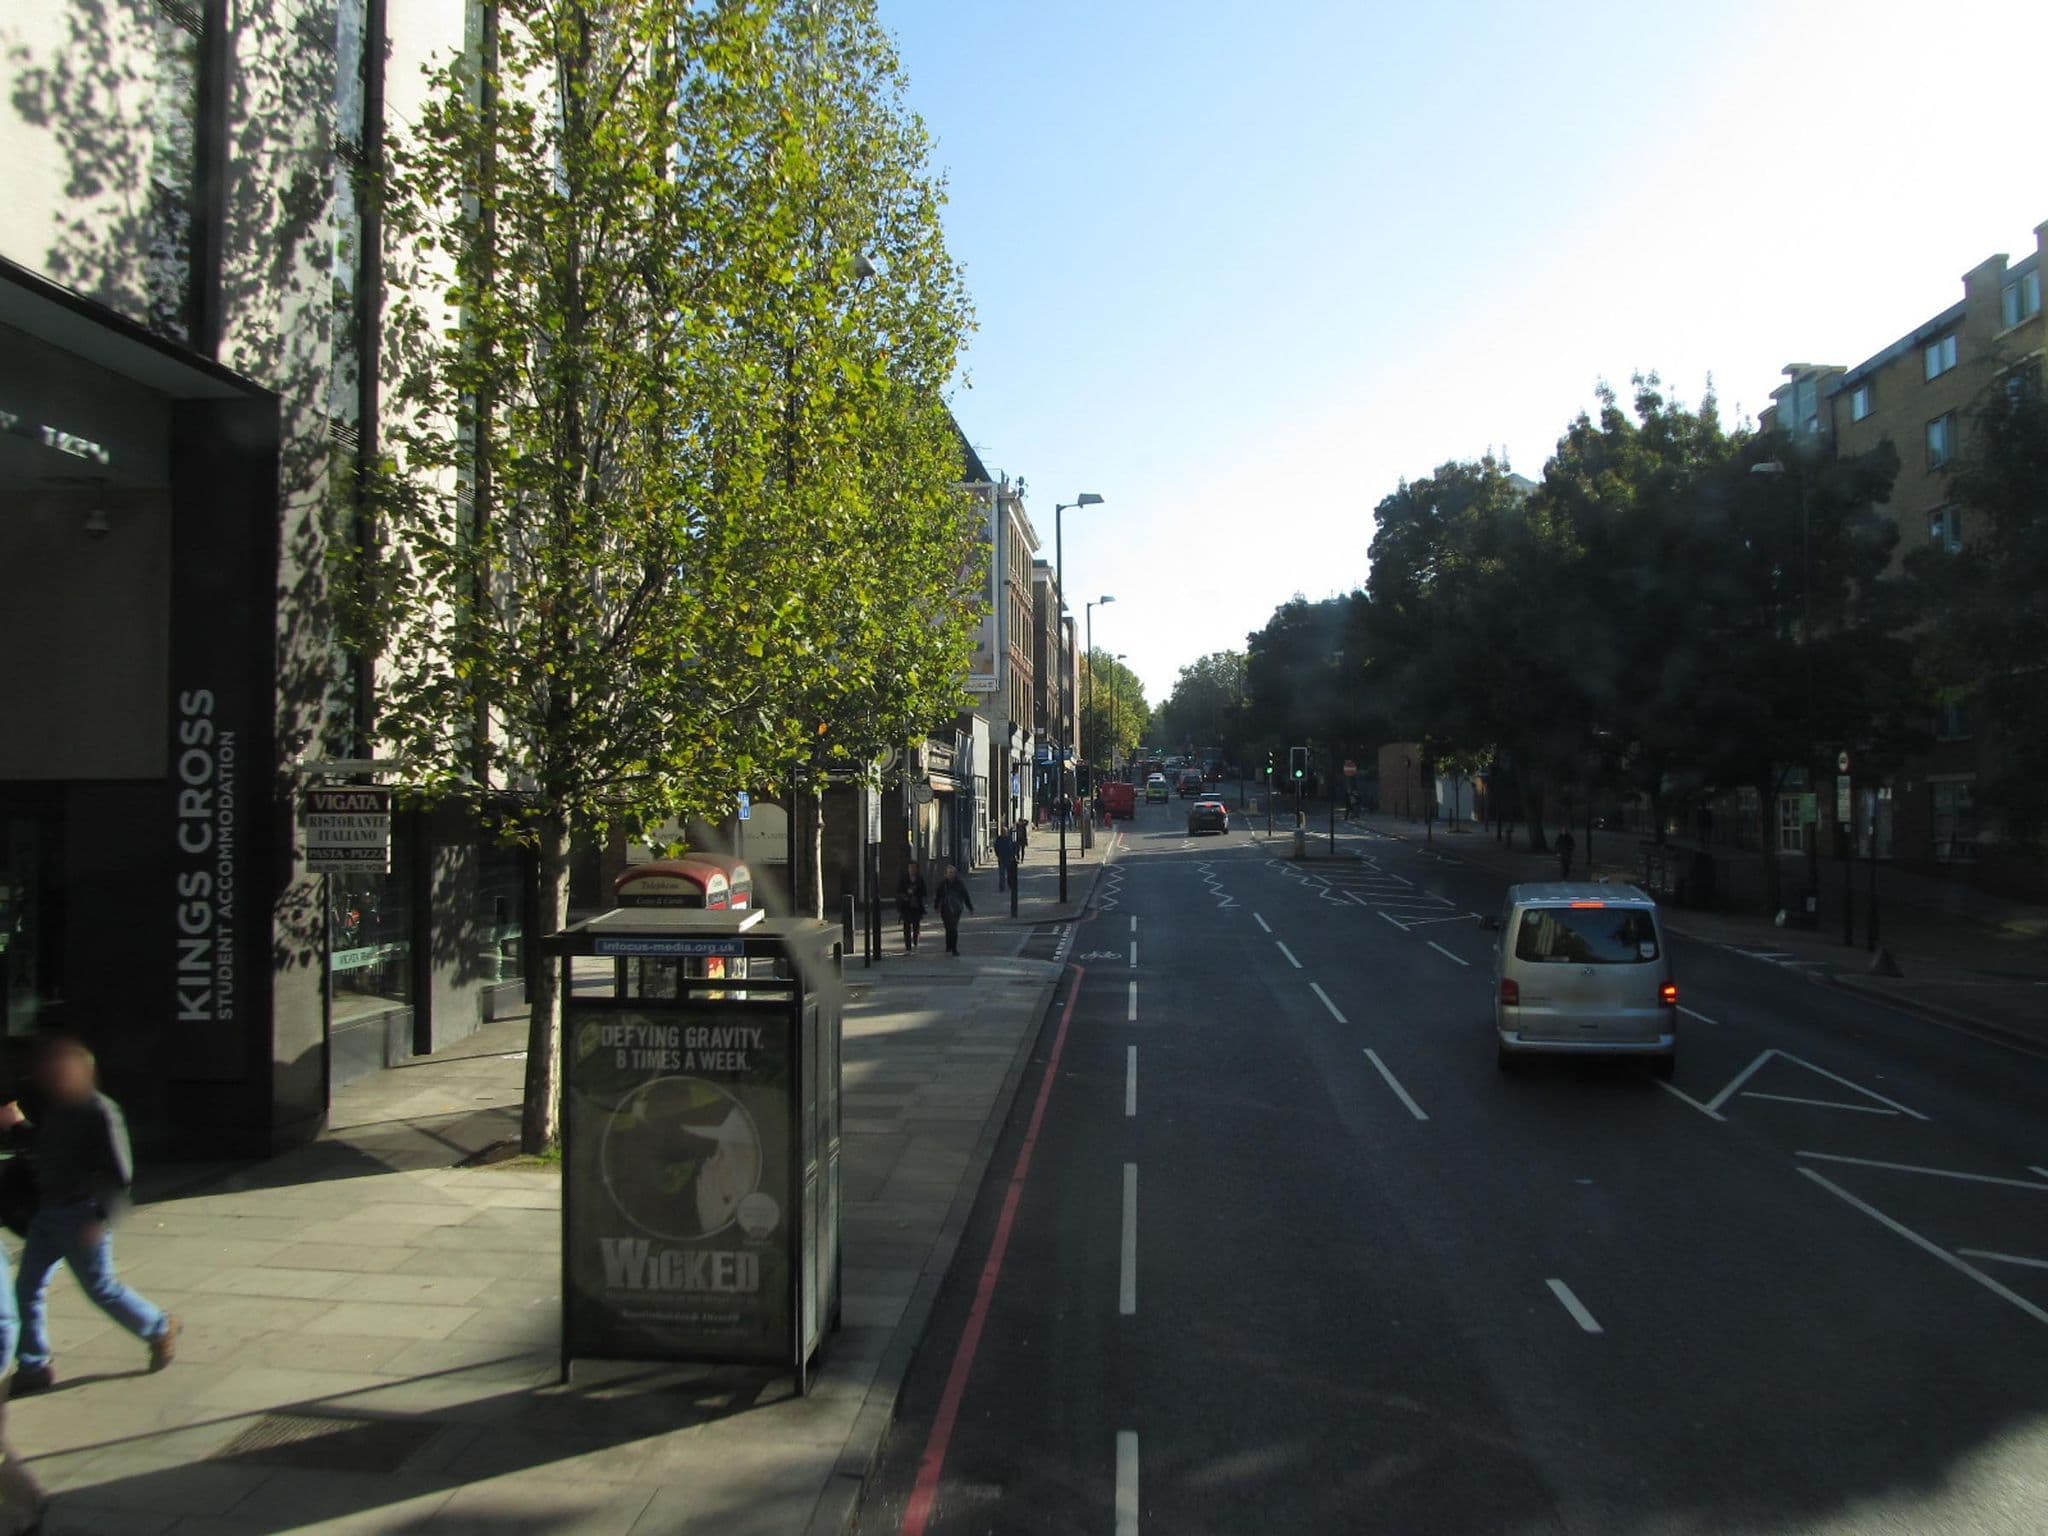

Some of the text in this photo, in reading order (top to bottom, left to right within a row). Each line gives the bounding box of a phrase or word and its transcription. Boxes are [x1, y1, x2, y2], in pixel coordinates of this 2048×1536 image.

[313, 793, 380, 810] VIGATA
[309, 815, 384, 828] RISTORANTE
[319, 829, 377, 841] ITALIANO
[177, 688, 214, 1021] KINGS CROSS
[217, 730, 235, 1020] STUDENT ACCOMMODATION
[601, 1025, 765, 1049] DEFYING GRAVITY.
[615, 1050, 752, 1071] 8 TIMES A WEEK.
